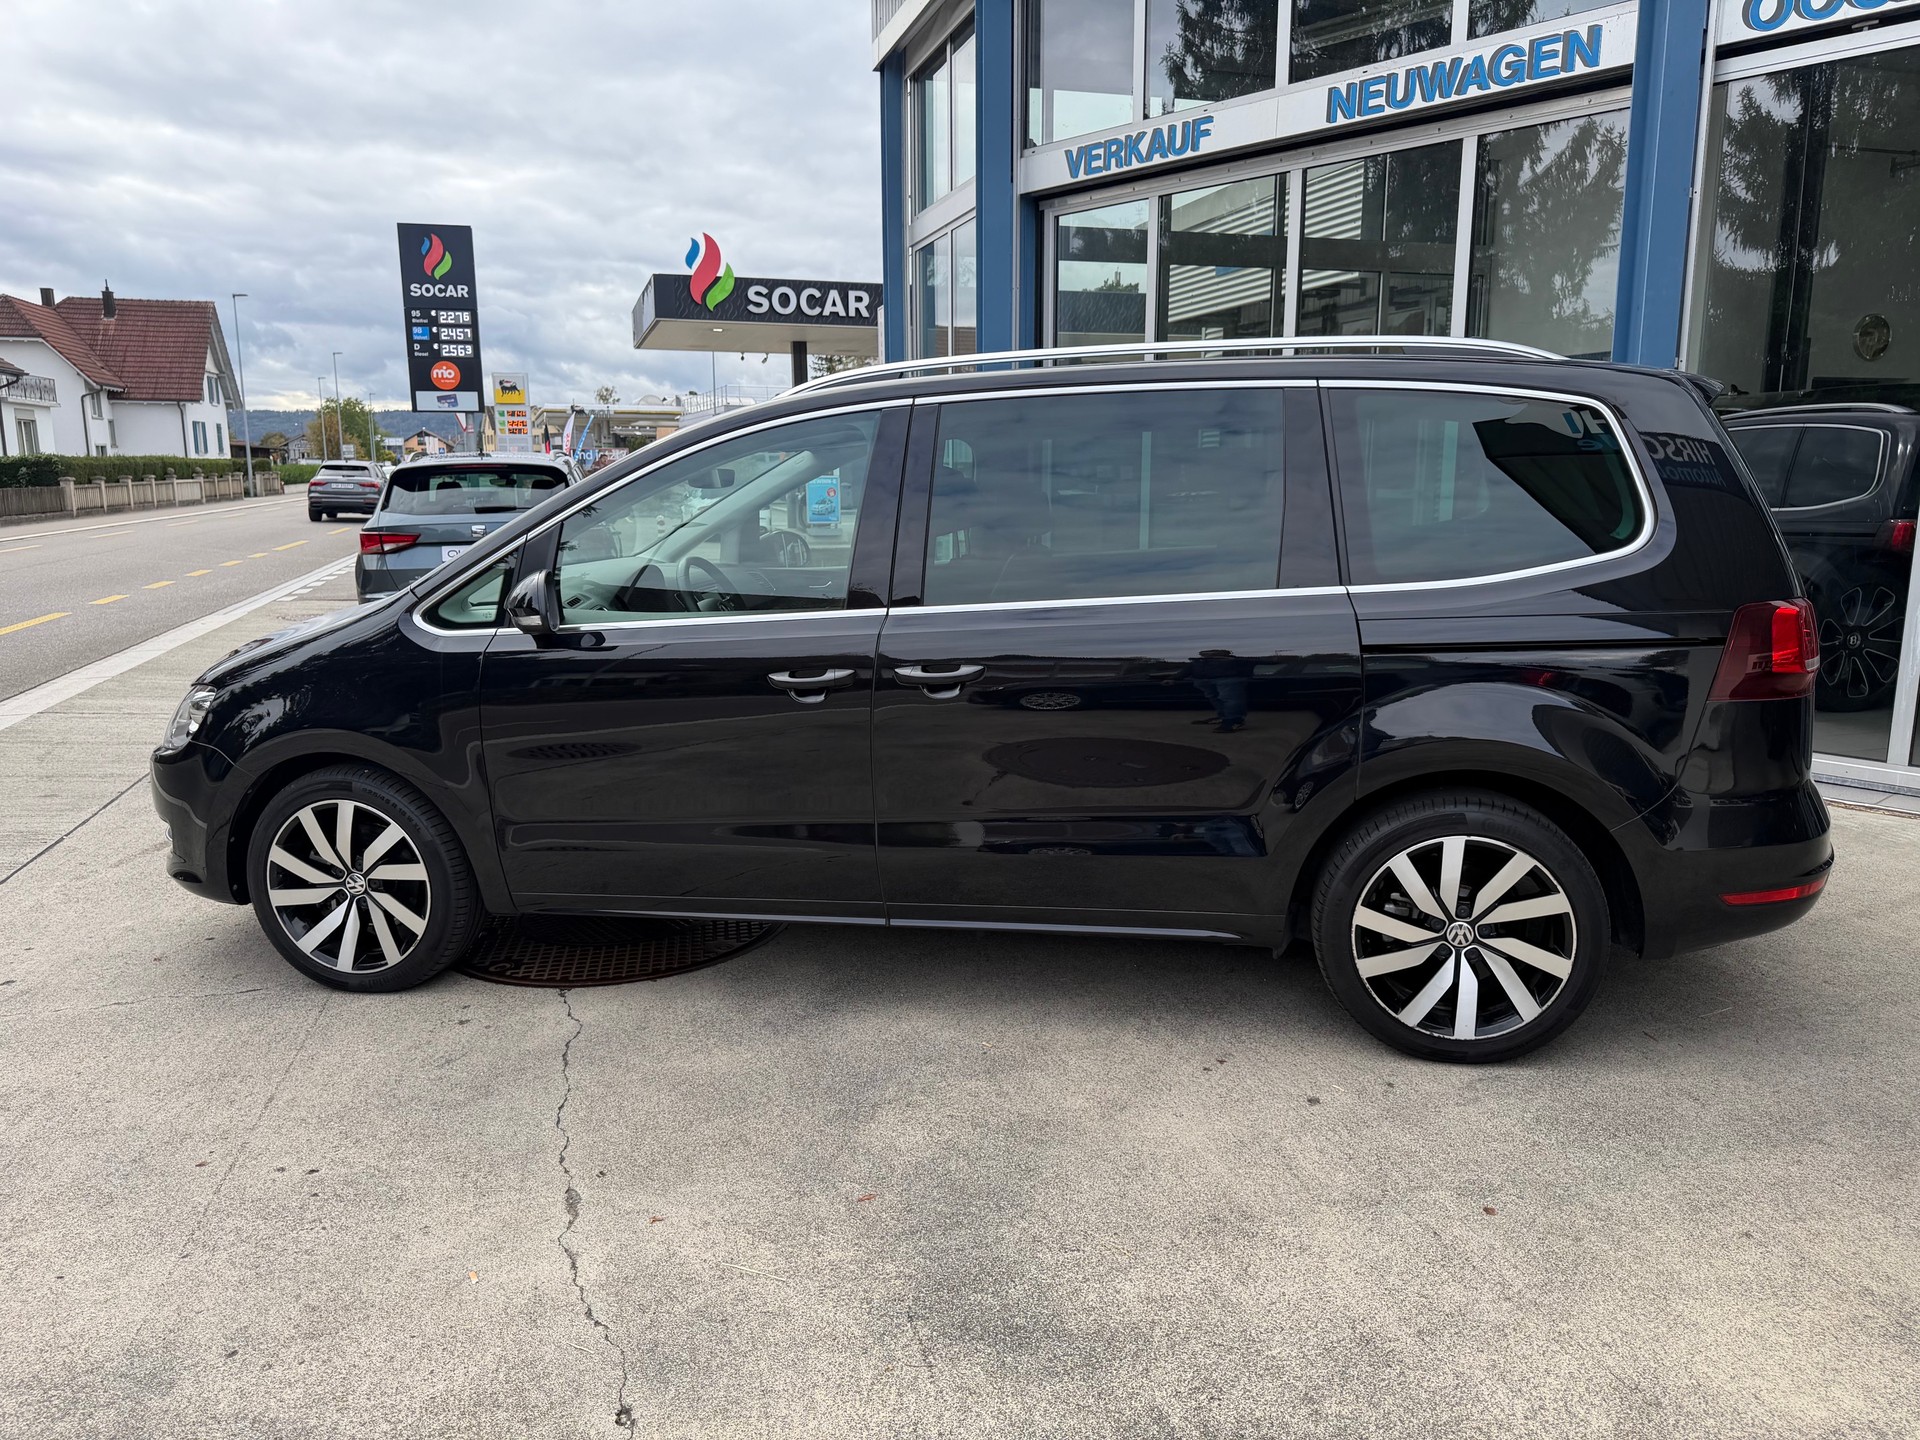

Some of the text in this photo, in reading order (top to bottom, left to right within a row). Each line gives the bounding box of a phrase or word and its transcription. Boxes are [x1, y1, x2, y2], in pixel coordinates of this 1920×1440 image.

[1064, 24, 1603, 179] VERKAUF NEUWAGEN
[410, 283, 469, 298] SOCAR
[746, 285, 870, 318] SOCAR
[433, 365, 455, 379] mio
